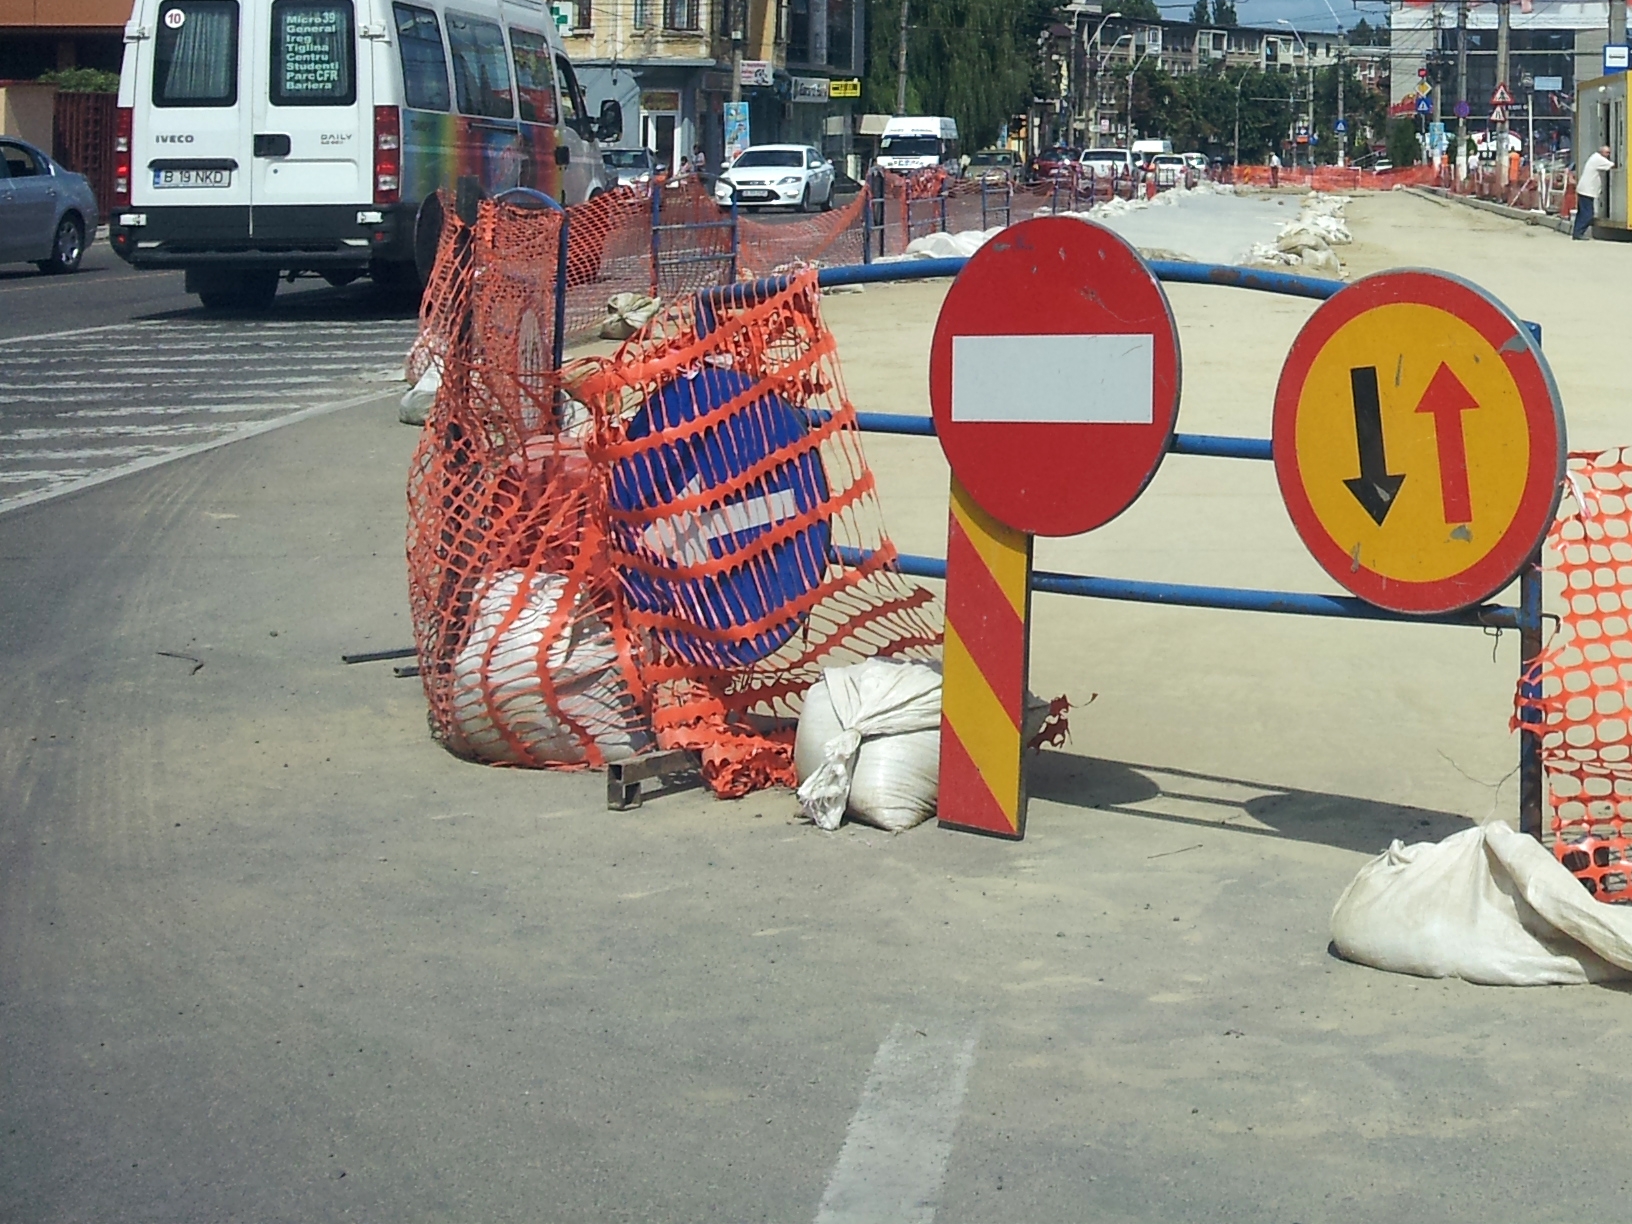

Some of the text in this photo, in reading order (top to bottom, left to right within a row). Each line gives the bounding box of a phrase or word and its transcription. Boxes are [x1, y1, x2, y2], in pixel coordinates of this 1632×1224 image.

[168, 13, 181, 24] 10
[286, 12, 336, 24] Micro 39
[286, 25, 336, 33] General
[285, 44, 329, 53] Tiglina
[286, 53, 329, 61] Centru
[286, 62, 339, 70] Studenti
[286, 70, 338, 81] Parc CFR
[155, 135, 194, 143] IVECO
[164, 171, 223, 184] B 19 NKD
